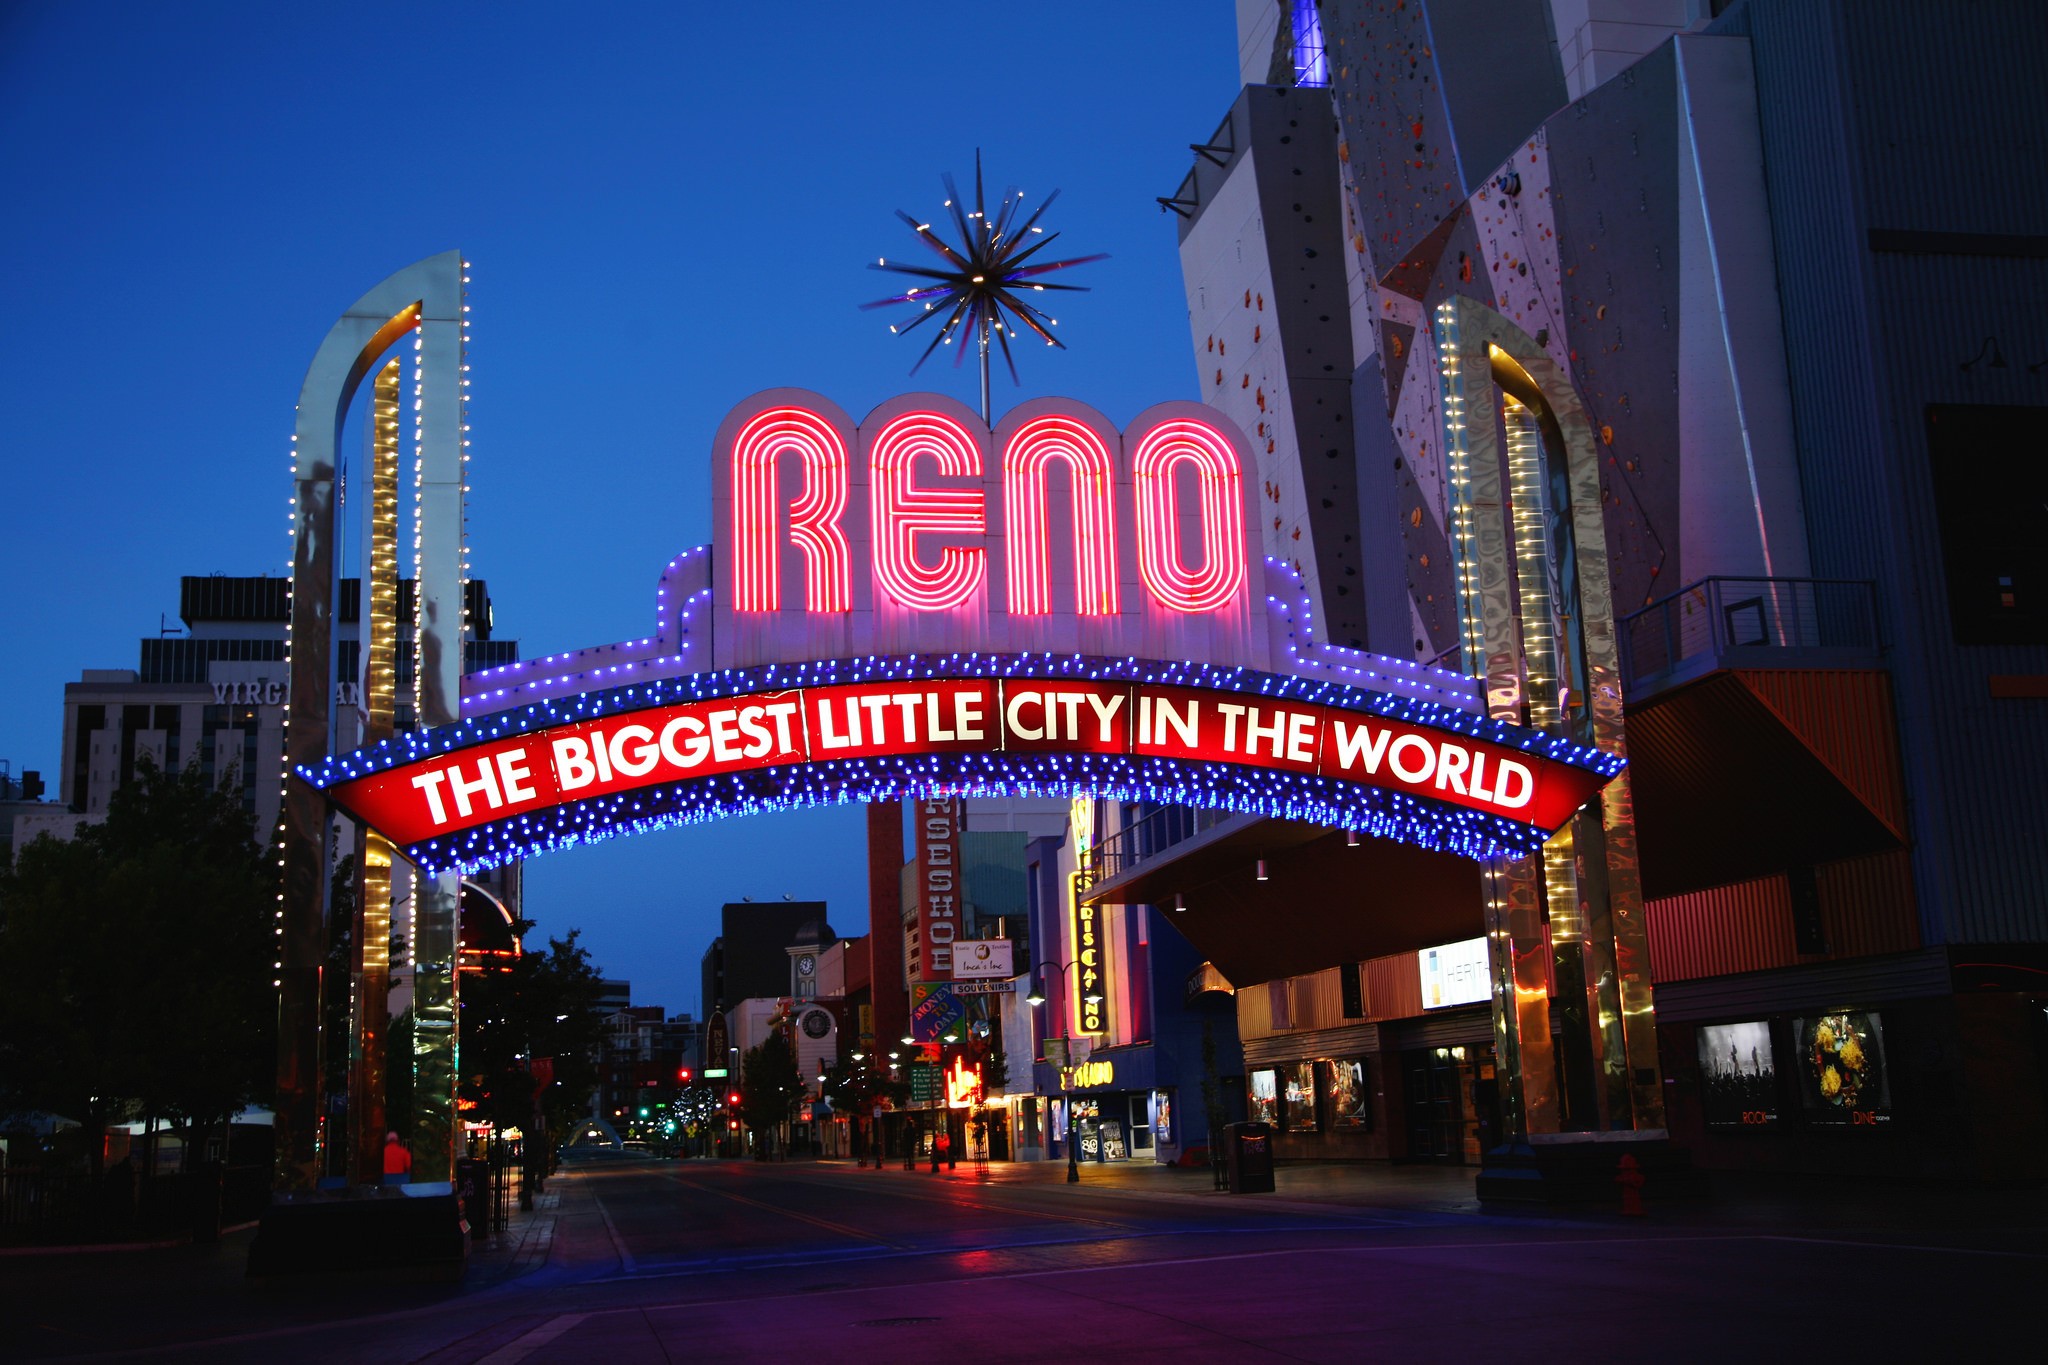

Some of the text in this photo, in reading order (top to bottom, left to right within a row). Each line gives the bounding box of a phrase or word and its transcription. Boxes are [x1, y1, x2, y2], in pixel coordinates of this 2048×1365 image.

[731, 406, 1246, 616] RENO
[211, 682, 359, 705] VIRGAN
[411, 691, 1534, 825] THE BIGGEST LITTLE CITY IN THE WORLD
[925, 794, 956, 971] RSESHOE
[963, 960, 1003, 971] Inca's Inc
[1447, 961, 1490, 983] HERITA
[957, 983, 1010, 993] SOUVENIRS
[914, 984, 951, 1021] MONEY
[931, 1002, 949, 1017] TO
[926, 1008, 958, 1038] LOAN
[712, 1029, 724, 1068] NEVA
[1743, 1111, 1767, 1125] ROCK
[1852, 1111, 1876, 1125] DINE
